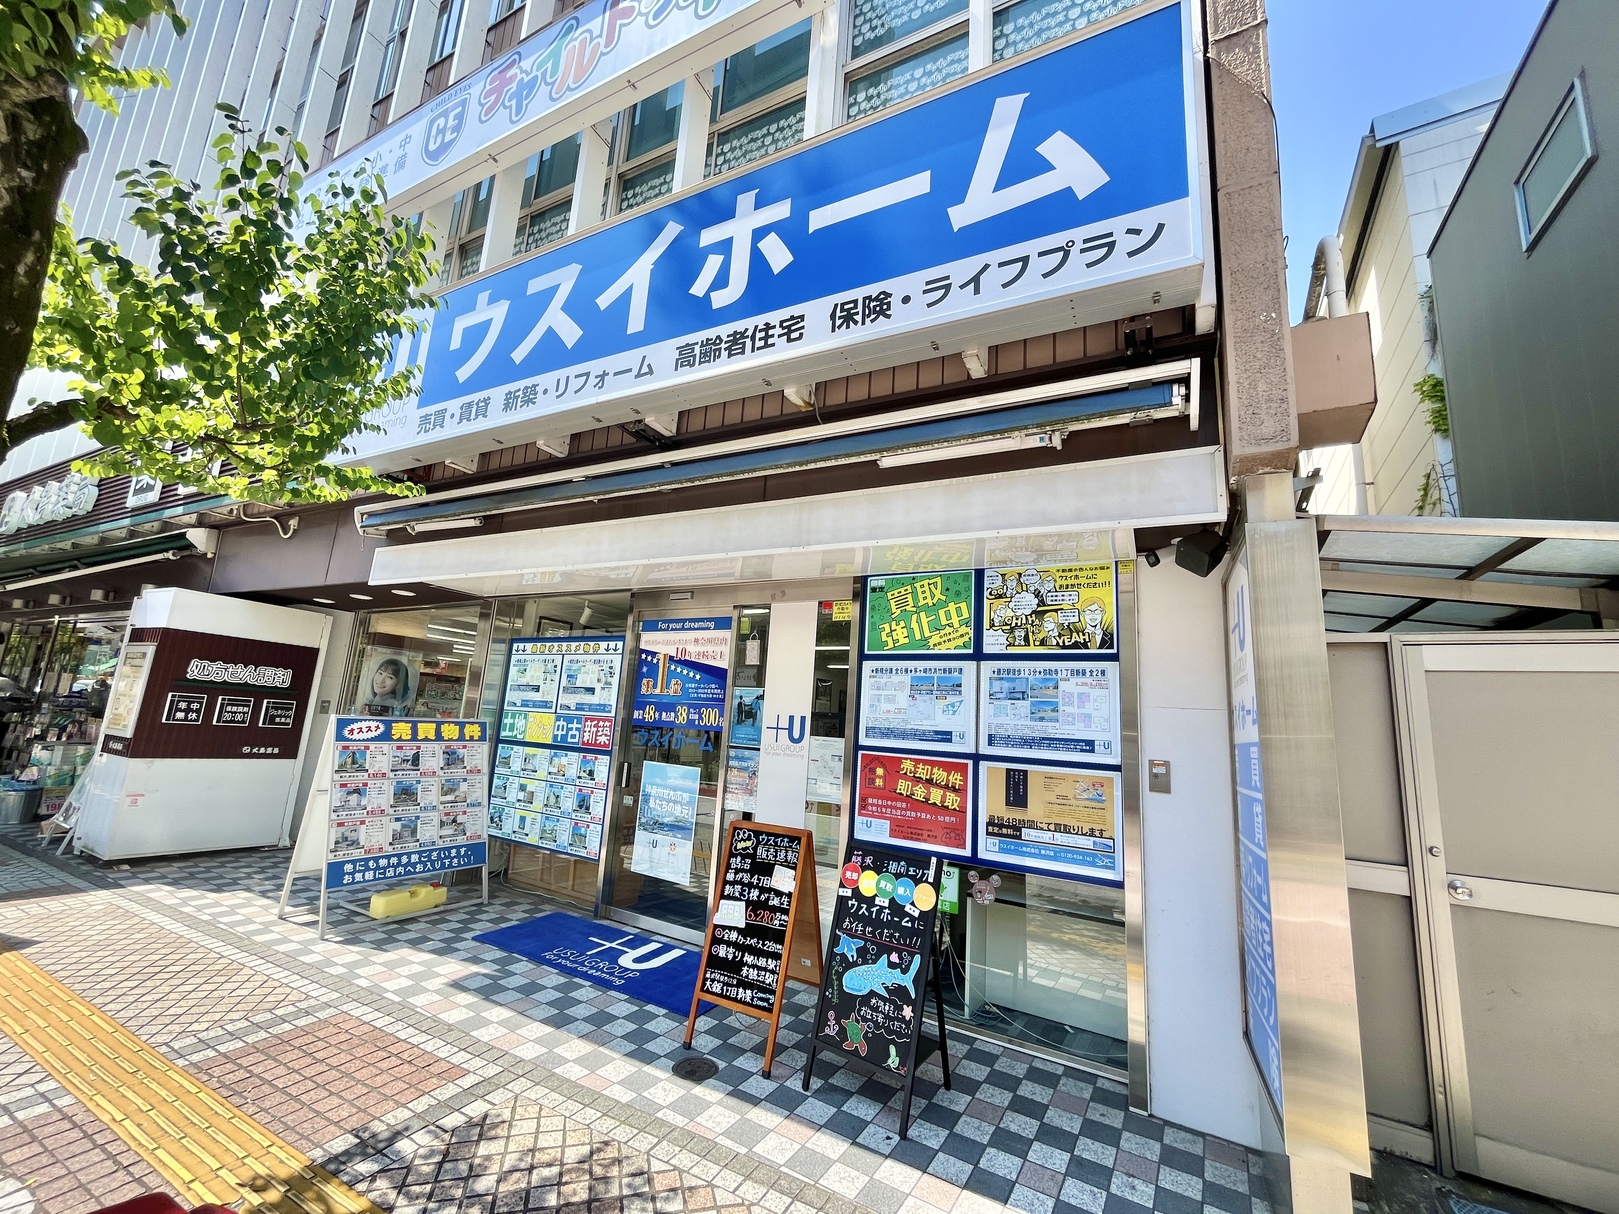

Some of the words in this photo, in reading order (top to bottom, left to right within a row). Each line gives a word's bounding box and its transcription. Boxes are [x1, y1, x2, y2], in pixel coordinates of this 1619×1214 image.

[428, 106, 462, 152] CE
[449, 92, 1111, 384] ウスイホーム
[416, 395, 491, 436] 売買・賃貸
[501, 355, 655, 414] 新築・リフォーム
[674, 314, 806, 374] 高齢者住宅
[829, 222, 1167, 333] 保険・ライフプラン
[886, 575, 947, 619] 買取
[658, 621, 669, 629] For
[669, 621, 683, 631] your
[684, 620, 715, 630] dreaming
[878, 600, 970, 651] 強化中
[1056, 632, 1090, 647] YEAH
[186, 658, 293, 688] 処方せん調剤
[347, 724, 382, 736] オススメ
[391, 722, 482, 741] 売買物件
[501, 712, 526, 739] 土地
[553, 717, 582, 743] 中古
[583, 719, 612, 745] 新築
[637, 728, 714, 752] ウスイホーム
[899, 758, 964, 790] 売却物件
[896, 778, 961, 811] 即金買取
[756, 846, 799, 864] 販売速報
[759, 833, 800, 850] ウスイホーム
[847, 898, 926, 931] ウスイホームに
[577, 964, 626, 986] dreaming
[583, 953, 640, 979] GROUP
